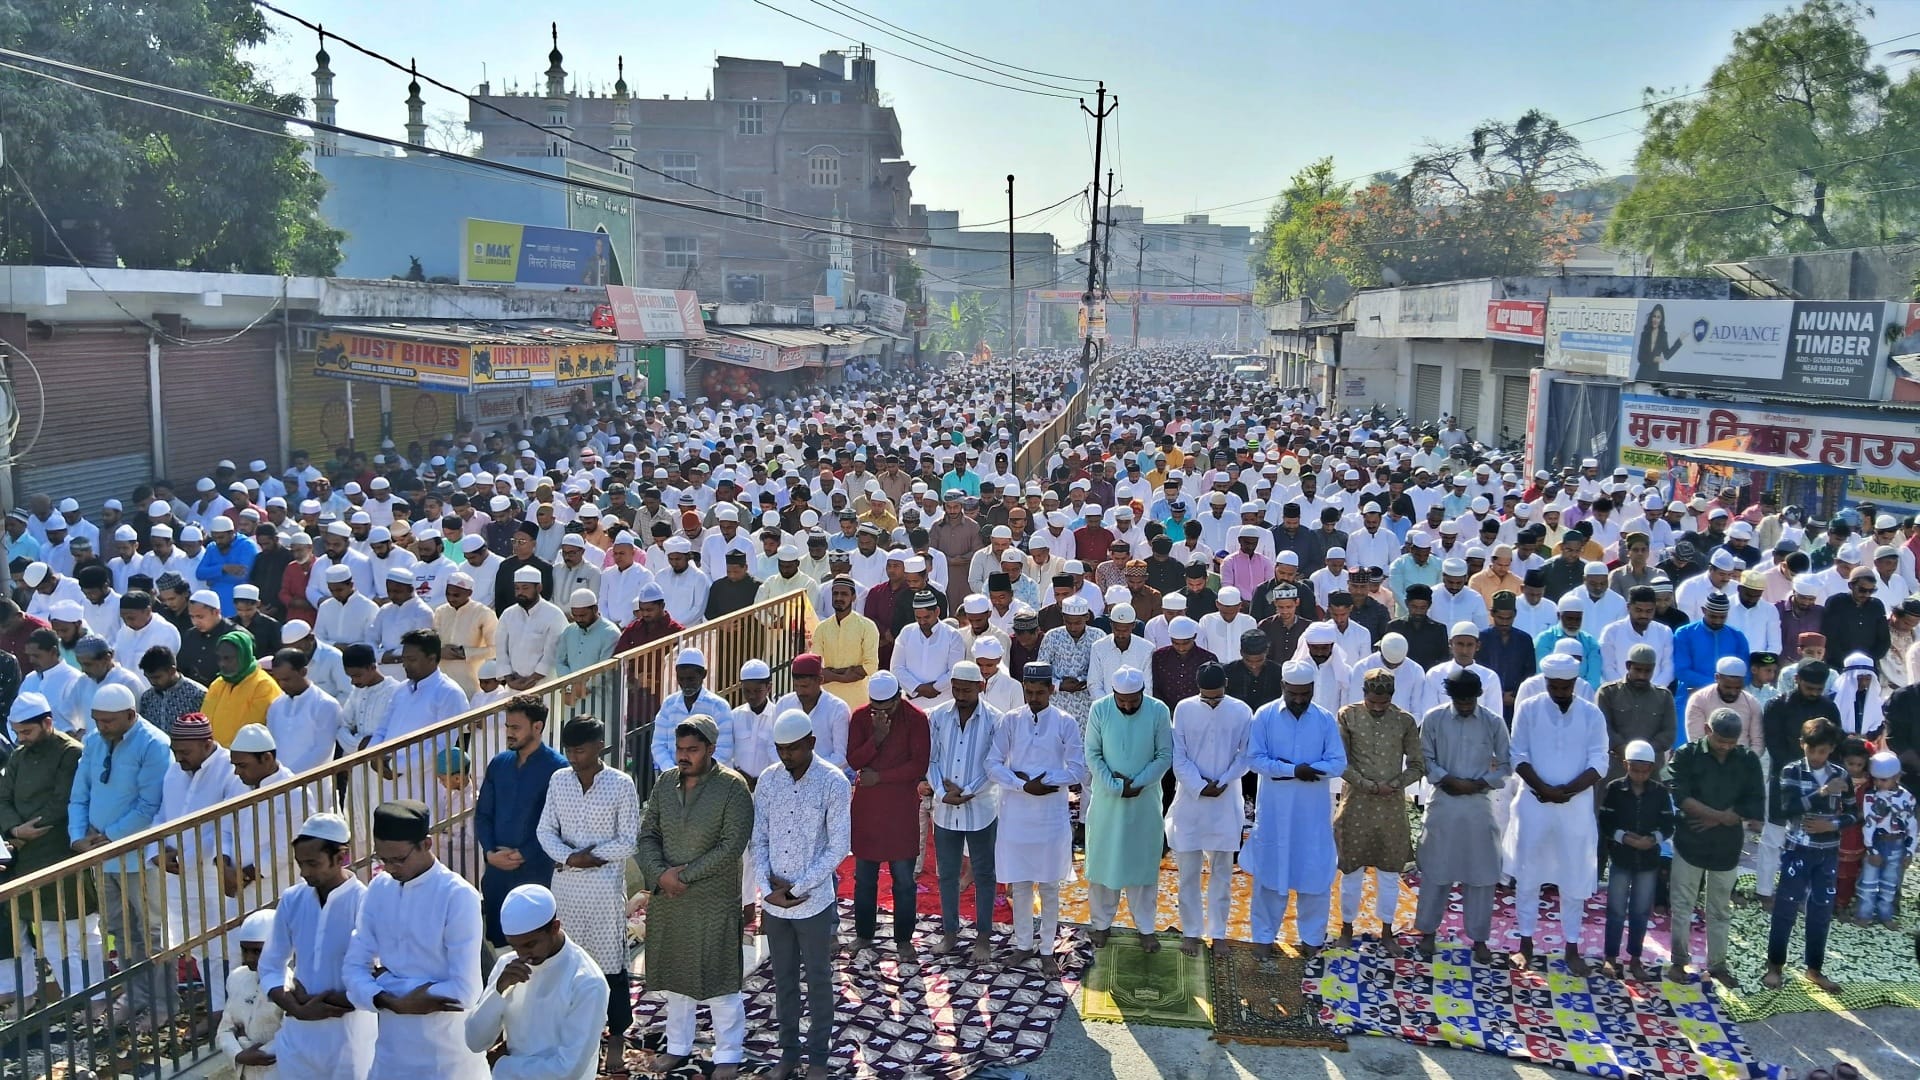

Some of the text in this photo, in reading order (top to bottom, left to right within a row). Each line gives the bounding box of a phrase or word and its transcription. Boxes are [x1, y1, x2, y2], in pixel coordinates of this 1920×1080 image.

[486, 243, 512, 259] MAK
[1798, 311, 1874, 332] MUNNA
[1709, 325, 1781, 342] ADVANCE
[350, 335, 461, 369] JUST BIKES
[1795, 334, 1871, 356] TIMBER
[493, 346, 551, 366] JUST BIKES
[1802, 364, 1818, 372] NEAR
[1628, 412, 1701, 447] मुन्ना
